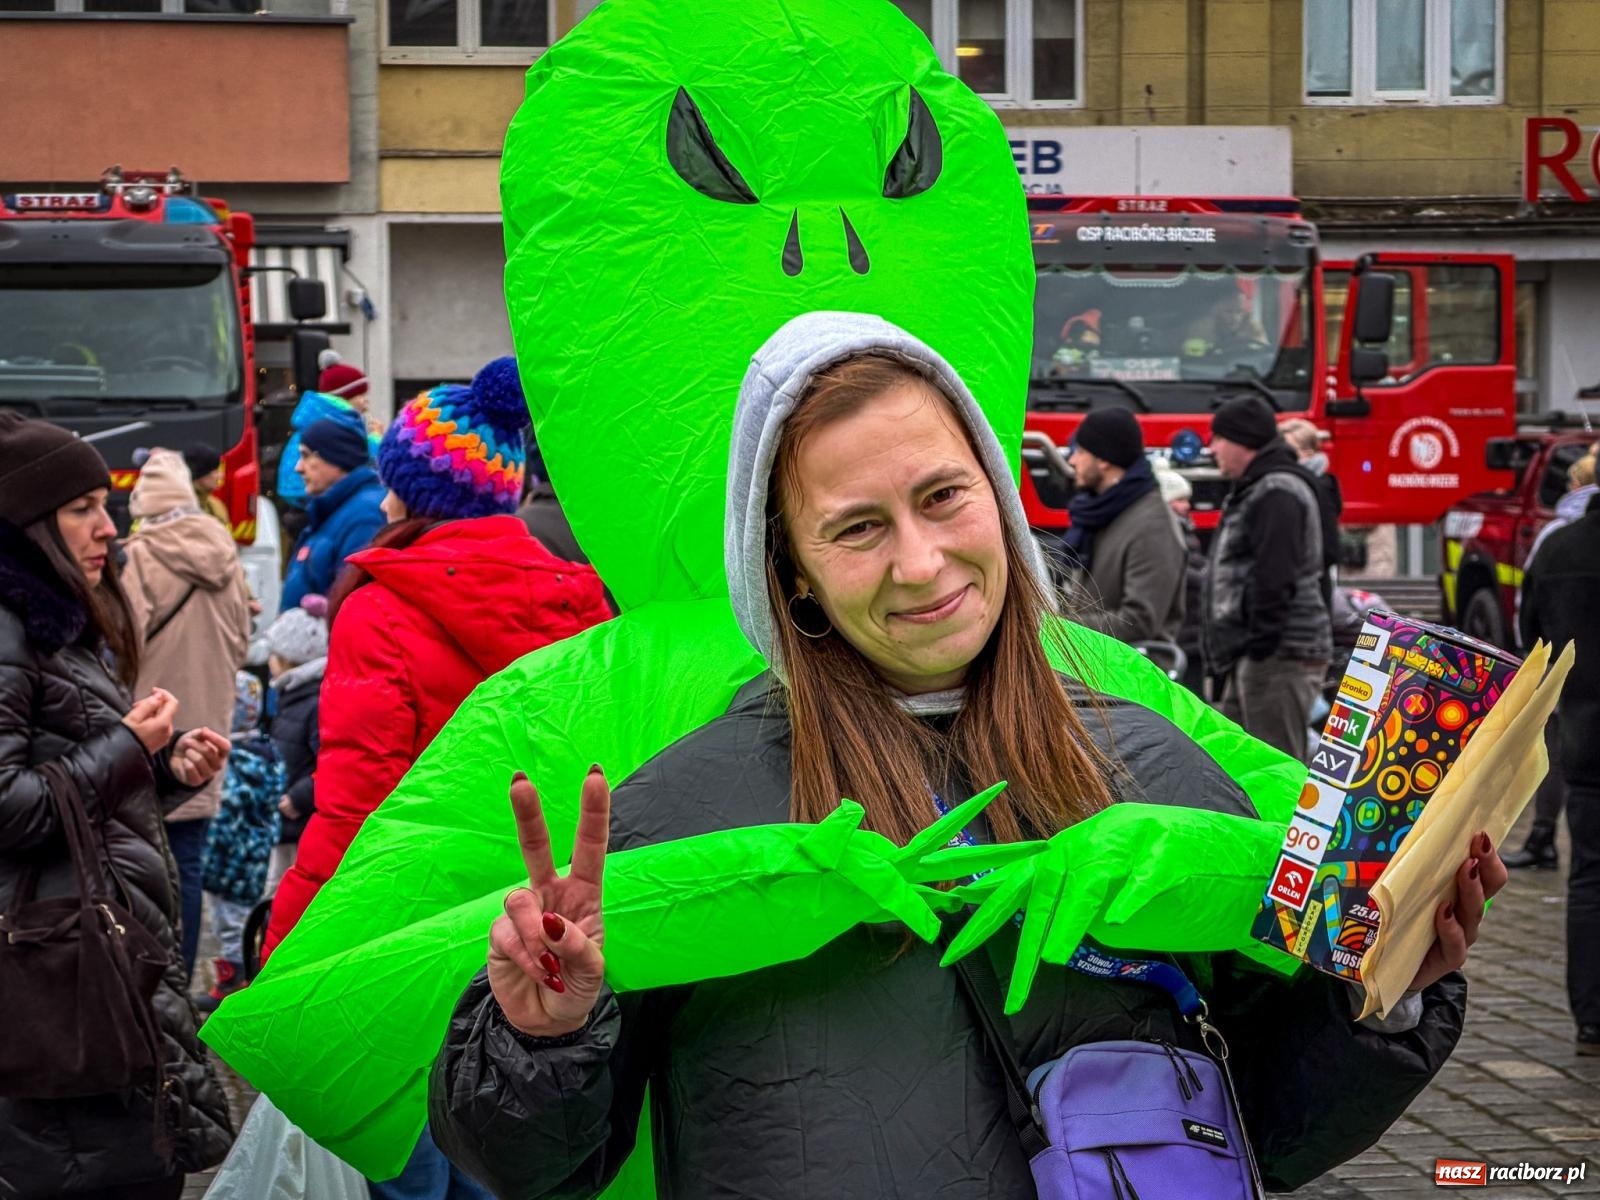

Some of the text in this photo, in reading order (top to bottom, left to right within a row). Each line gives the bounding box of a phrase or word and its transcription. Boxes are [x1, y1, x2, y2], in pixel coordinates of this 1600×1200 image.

[1524, 116, 1600, 203] R
[1327, 713, 1360, 737] ank
[1312, 750, 1347, 772] AY
[1286, 826, 1321, 851] gro
[1277, 885, 1302, 901] ORLEN
[1348, 904, 1381, 922] 25.0
[1077, 959, 1112, 975] PIERWSZA
[1087, 954, 1114, 969] POMOC
